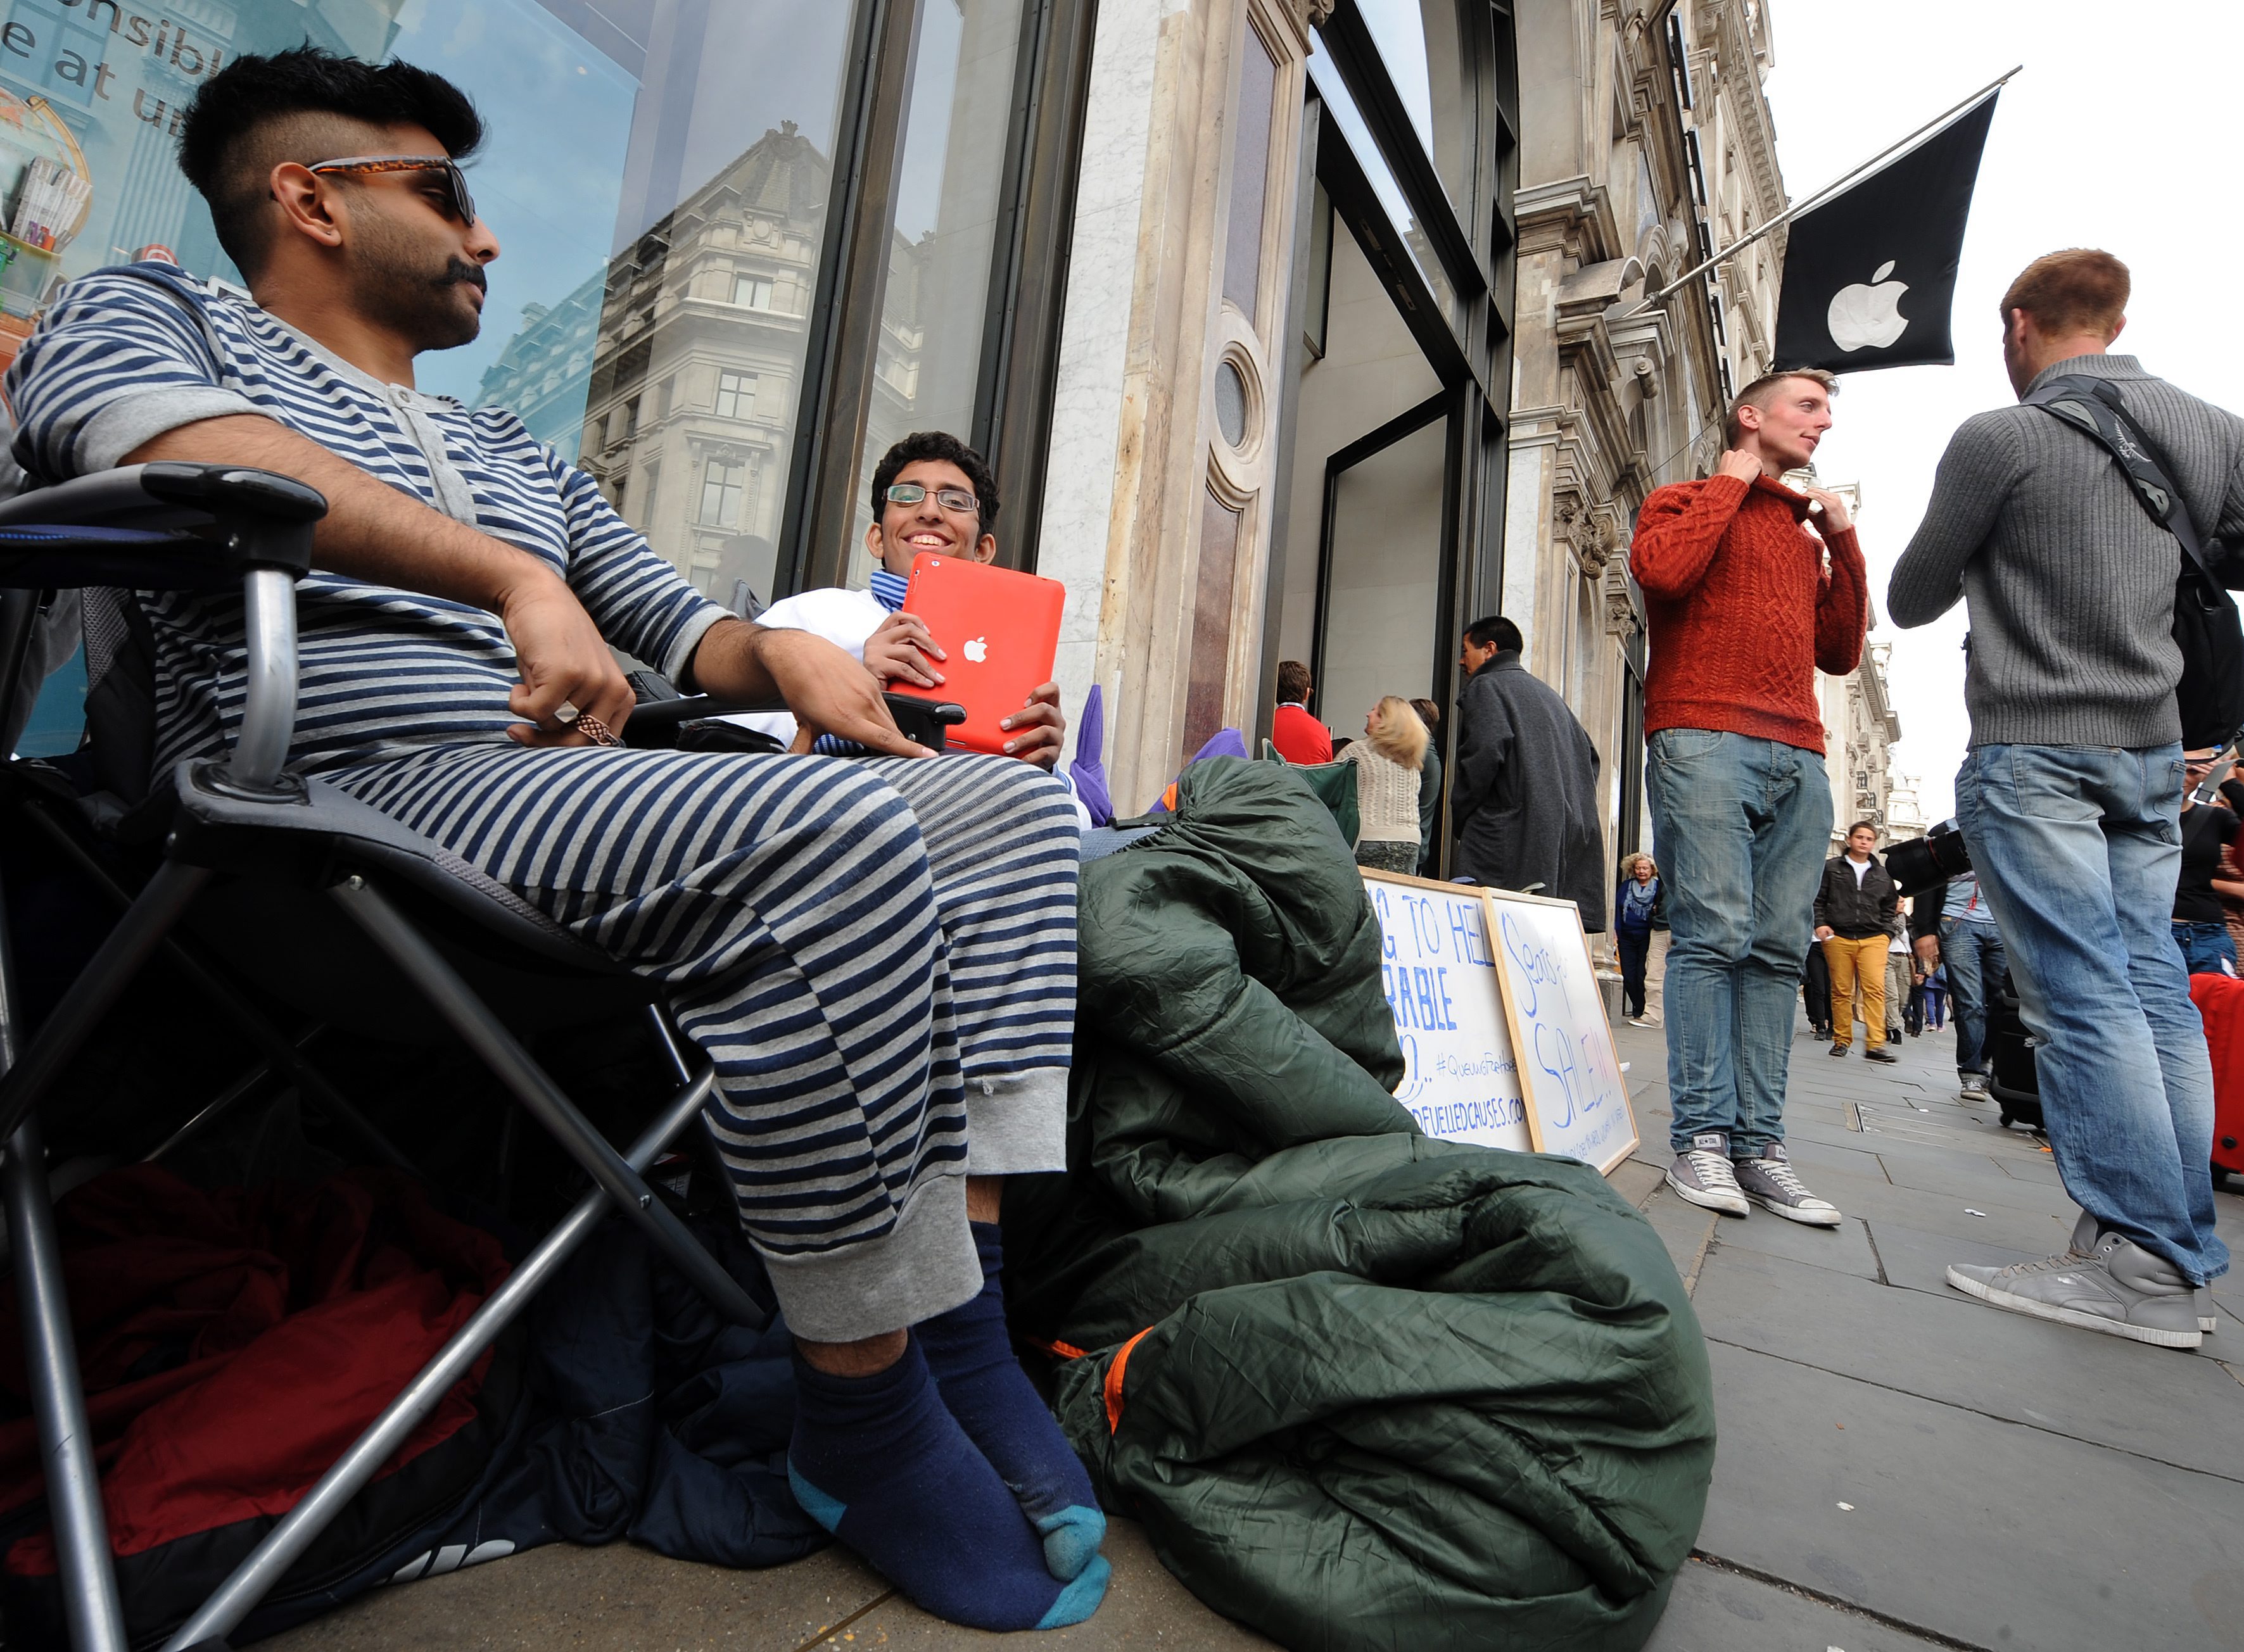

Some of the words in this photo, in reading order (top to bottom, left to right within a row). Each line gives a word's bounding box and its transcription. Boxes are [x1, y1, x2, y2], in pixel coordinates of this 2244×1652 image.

[56, 0, 222, 80] nsibl
[54, 48, 115, 101] at
[1402, 895, 1440, 959] TO
[1382, 964, 1457, 1031] RABLE
[1501, 912, 1557, 1019] Seats
